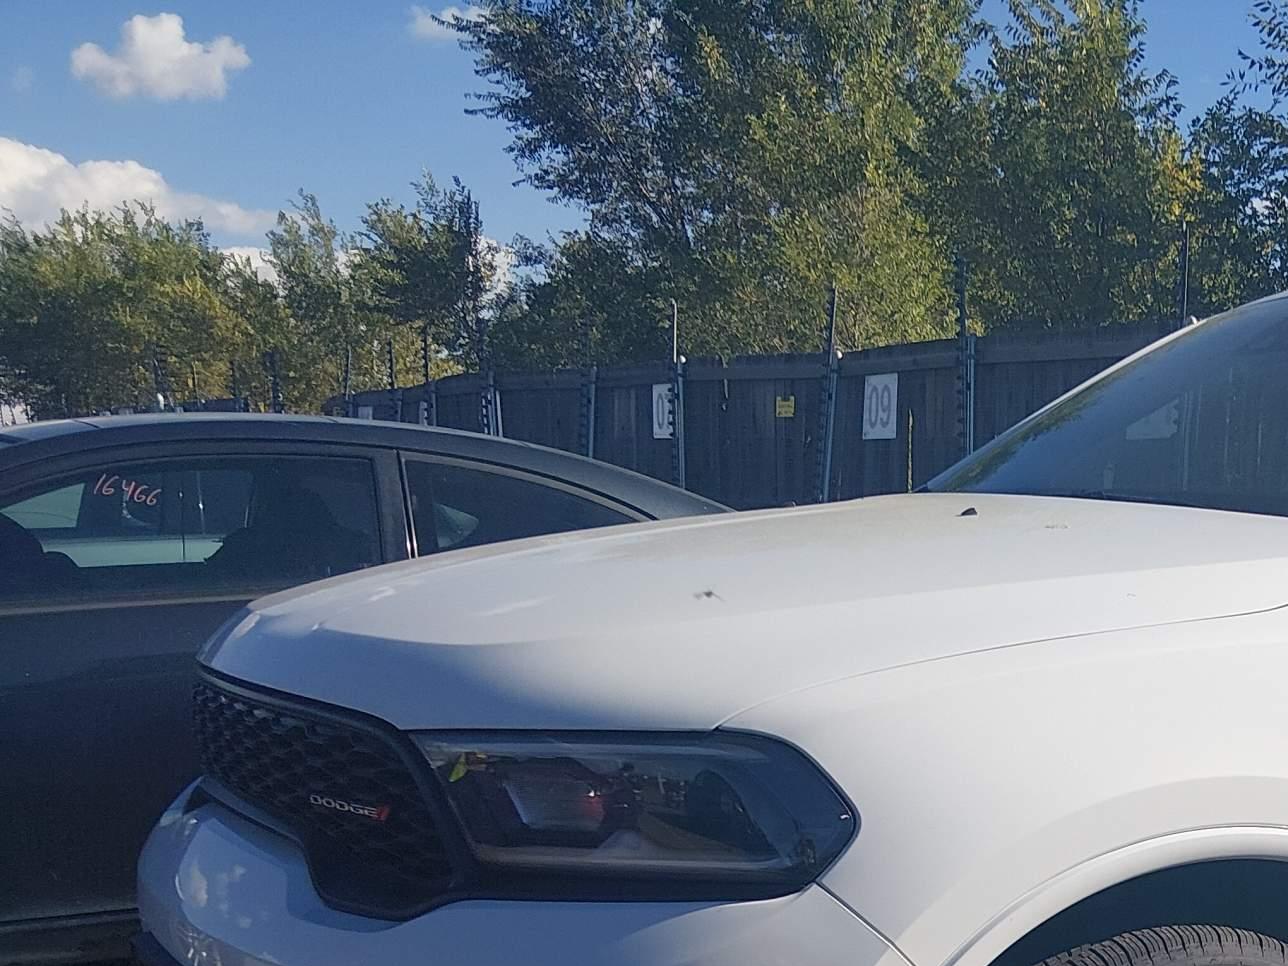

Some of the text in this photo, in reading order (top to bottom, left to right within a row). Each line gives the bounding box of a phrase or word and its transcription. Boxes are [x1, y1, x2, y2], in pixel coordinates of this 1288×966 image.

[867, 385, 892, 429] 09
[93, 474, 162, 506] 16466
[309, 794, 379, 818] DODGE
